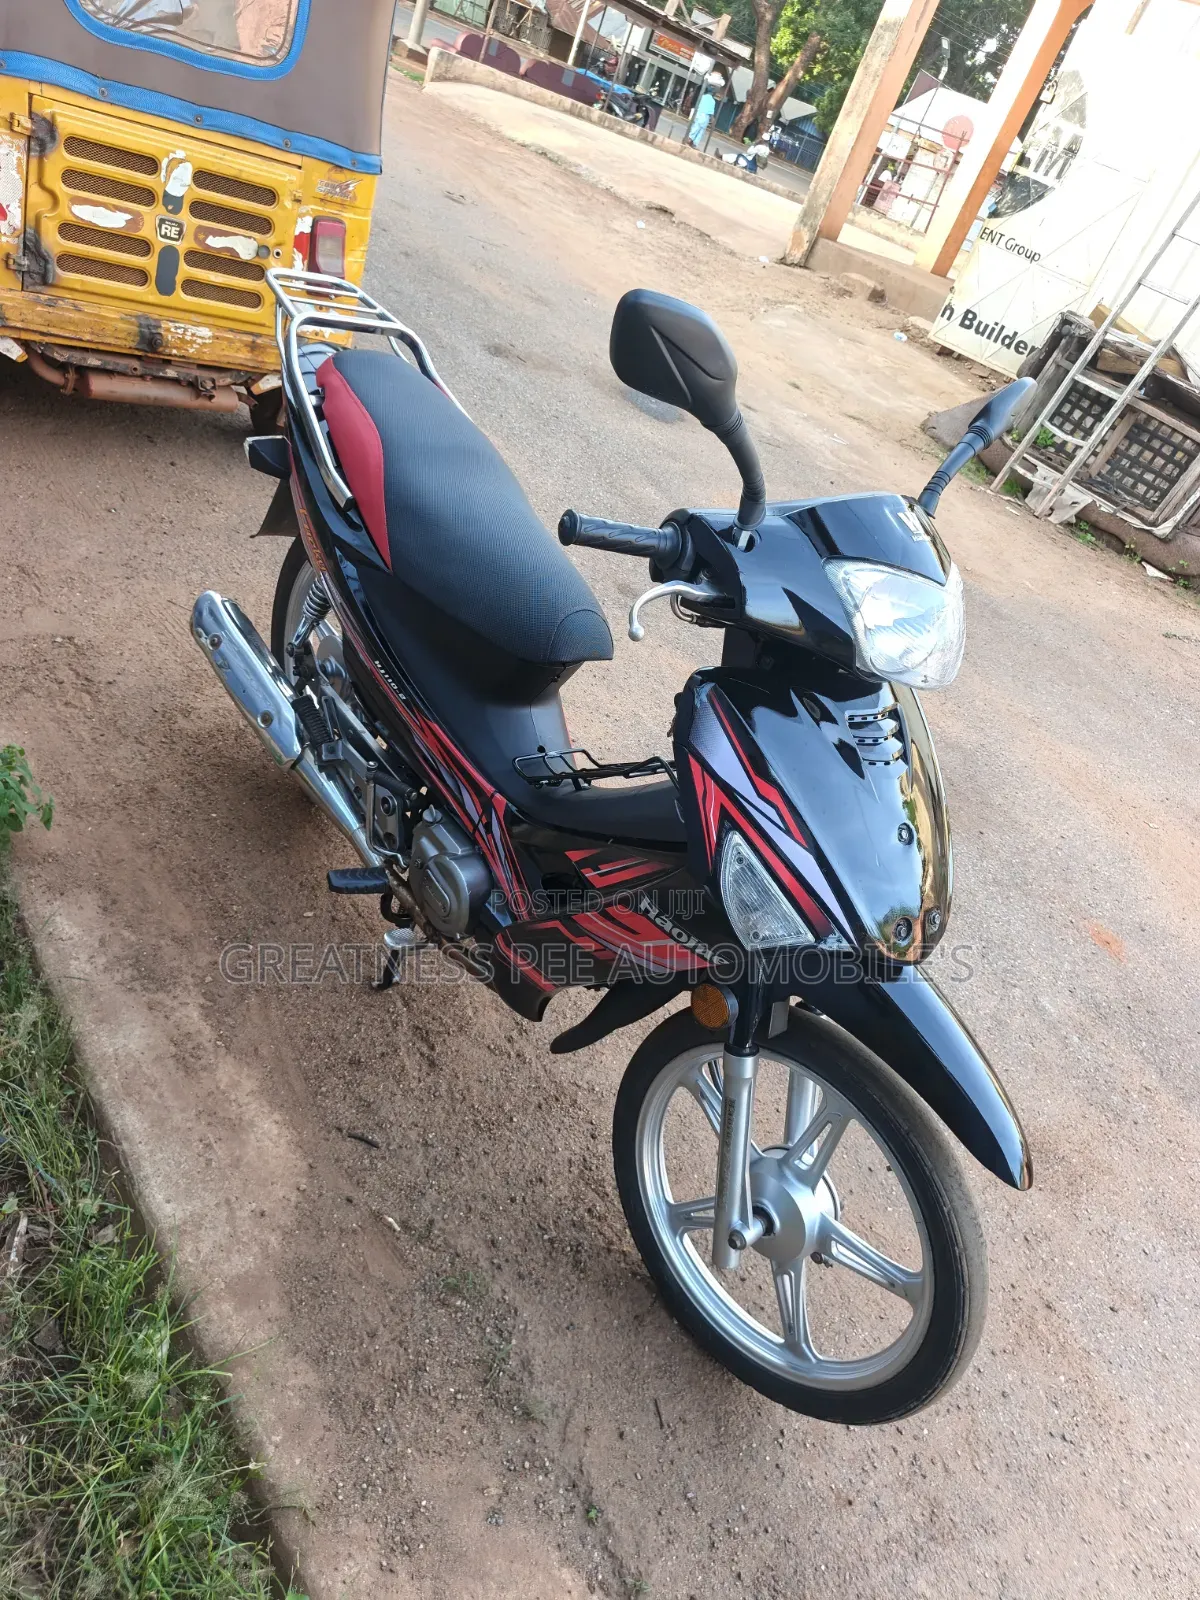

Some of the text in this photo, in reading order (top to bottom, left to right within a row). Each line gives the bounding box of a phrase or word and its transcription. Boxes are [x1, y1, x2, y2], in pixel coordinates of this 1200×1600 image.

[161, 223, 180, 239] RE
[979, 226, 1041, 264] ENT Group
